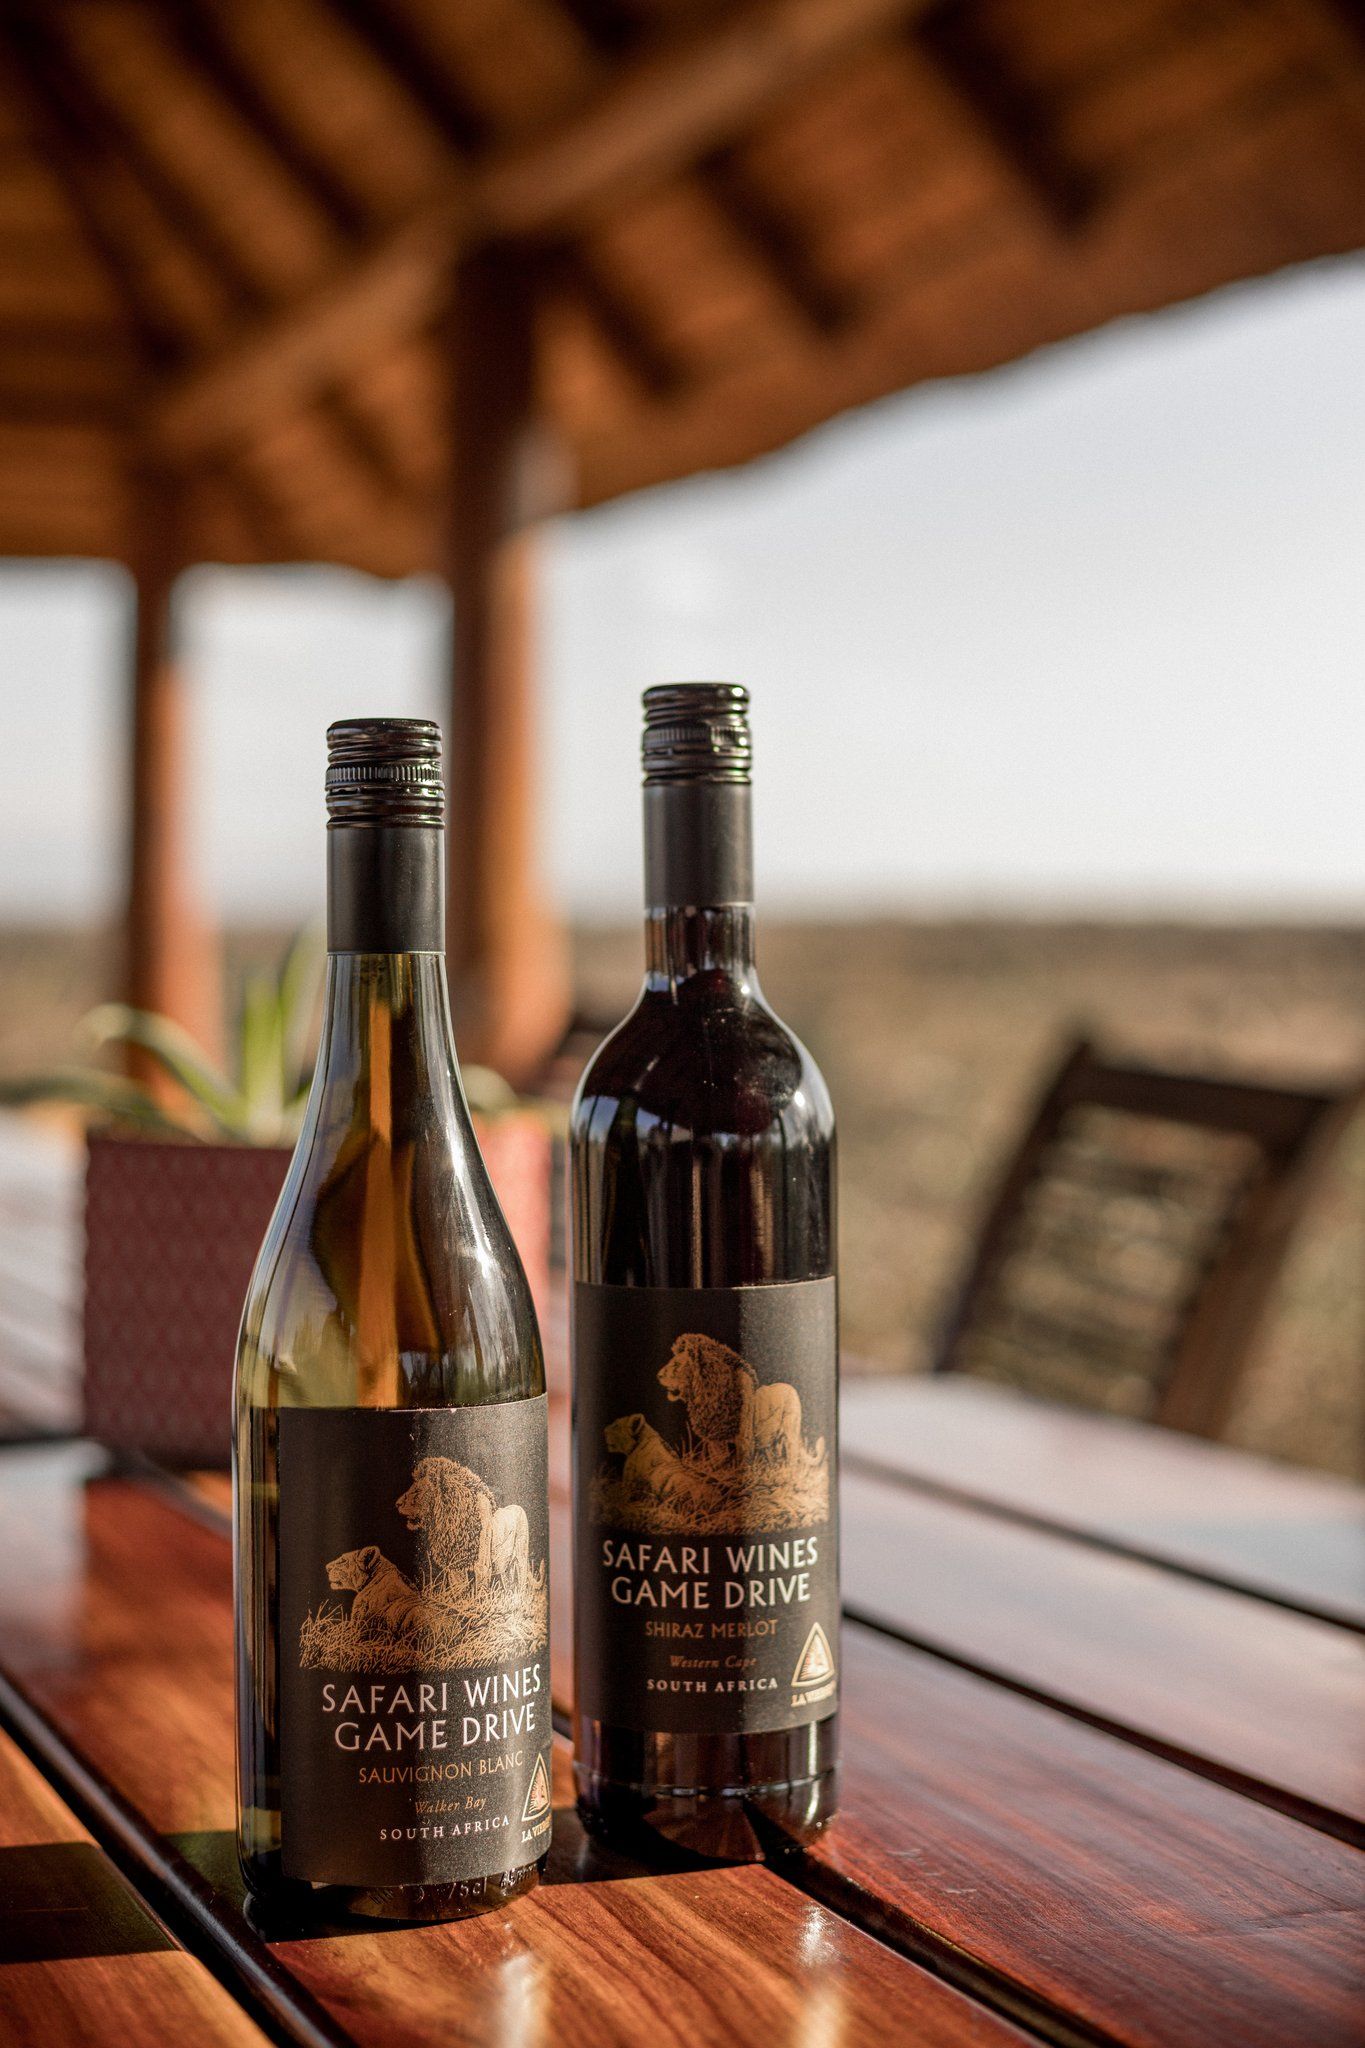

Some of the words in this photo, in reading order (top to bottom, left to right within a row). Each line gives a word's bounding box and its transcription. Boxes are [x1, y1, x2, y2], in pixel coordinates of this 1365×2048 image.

[602, 1539, 710, 1574] SAFARI
[725, 1536, 818, 1573] WINES
[611, 1576, 709, 1609] GAME
[725, 1572, 811, 1609] DRIVE
[645, 1621, 705, 1638] SHIRAZ
[711, 1619, 778, 1638] MERLOT
[669, 1655, 719, 1668] Western
[725, 1655, 757, 1670] Cape
[322, 1682, 448, 1714] SAFARI
[464, 1663, 541, 1708] WINES
[647, 1679, 707, 1692] SOUTH
[714, 1677, 778, 1692] AFRICA
[334, 1719, 448, 1751] GAME
[462, 1702, 536, 1746] DRIVE
[359, 1761, 472, 1784] SAUVIGNON
[479, 1750, 524, 1775] BLANC
[415, 1799, 460, 1814] Walker
[464, 1795, 487, 1811] Bay
[380, 1825, 444, 1840] SOUTH
[452, 1815, 510, 1836] AFRICA
